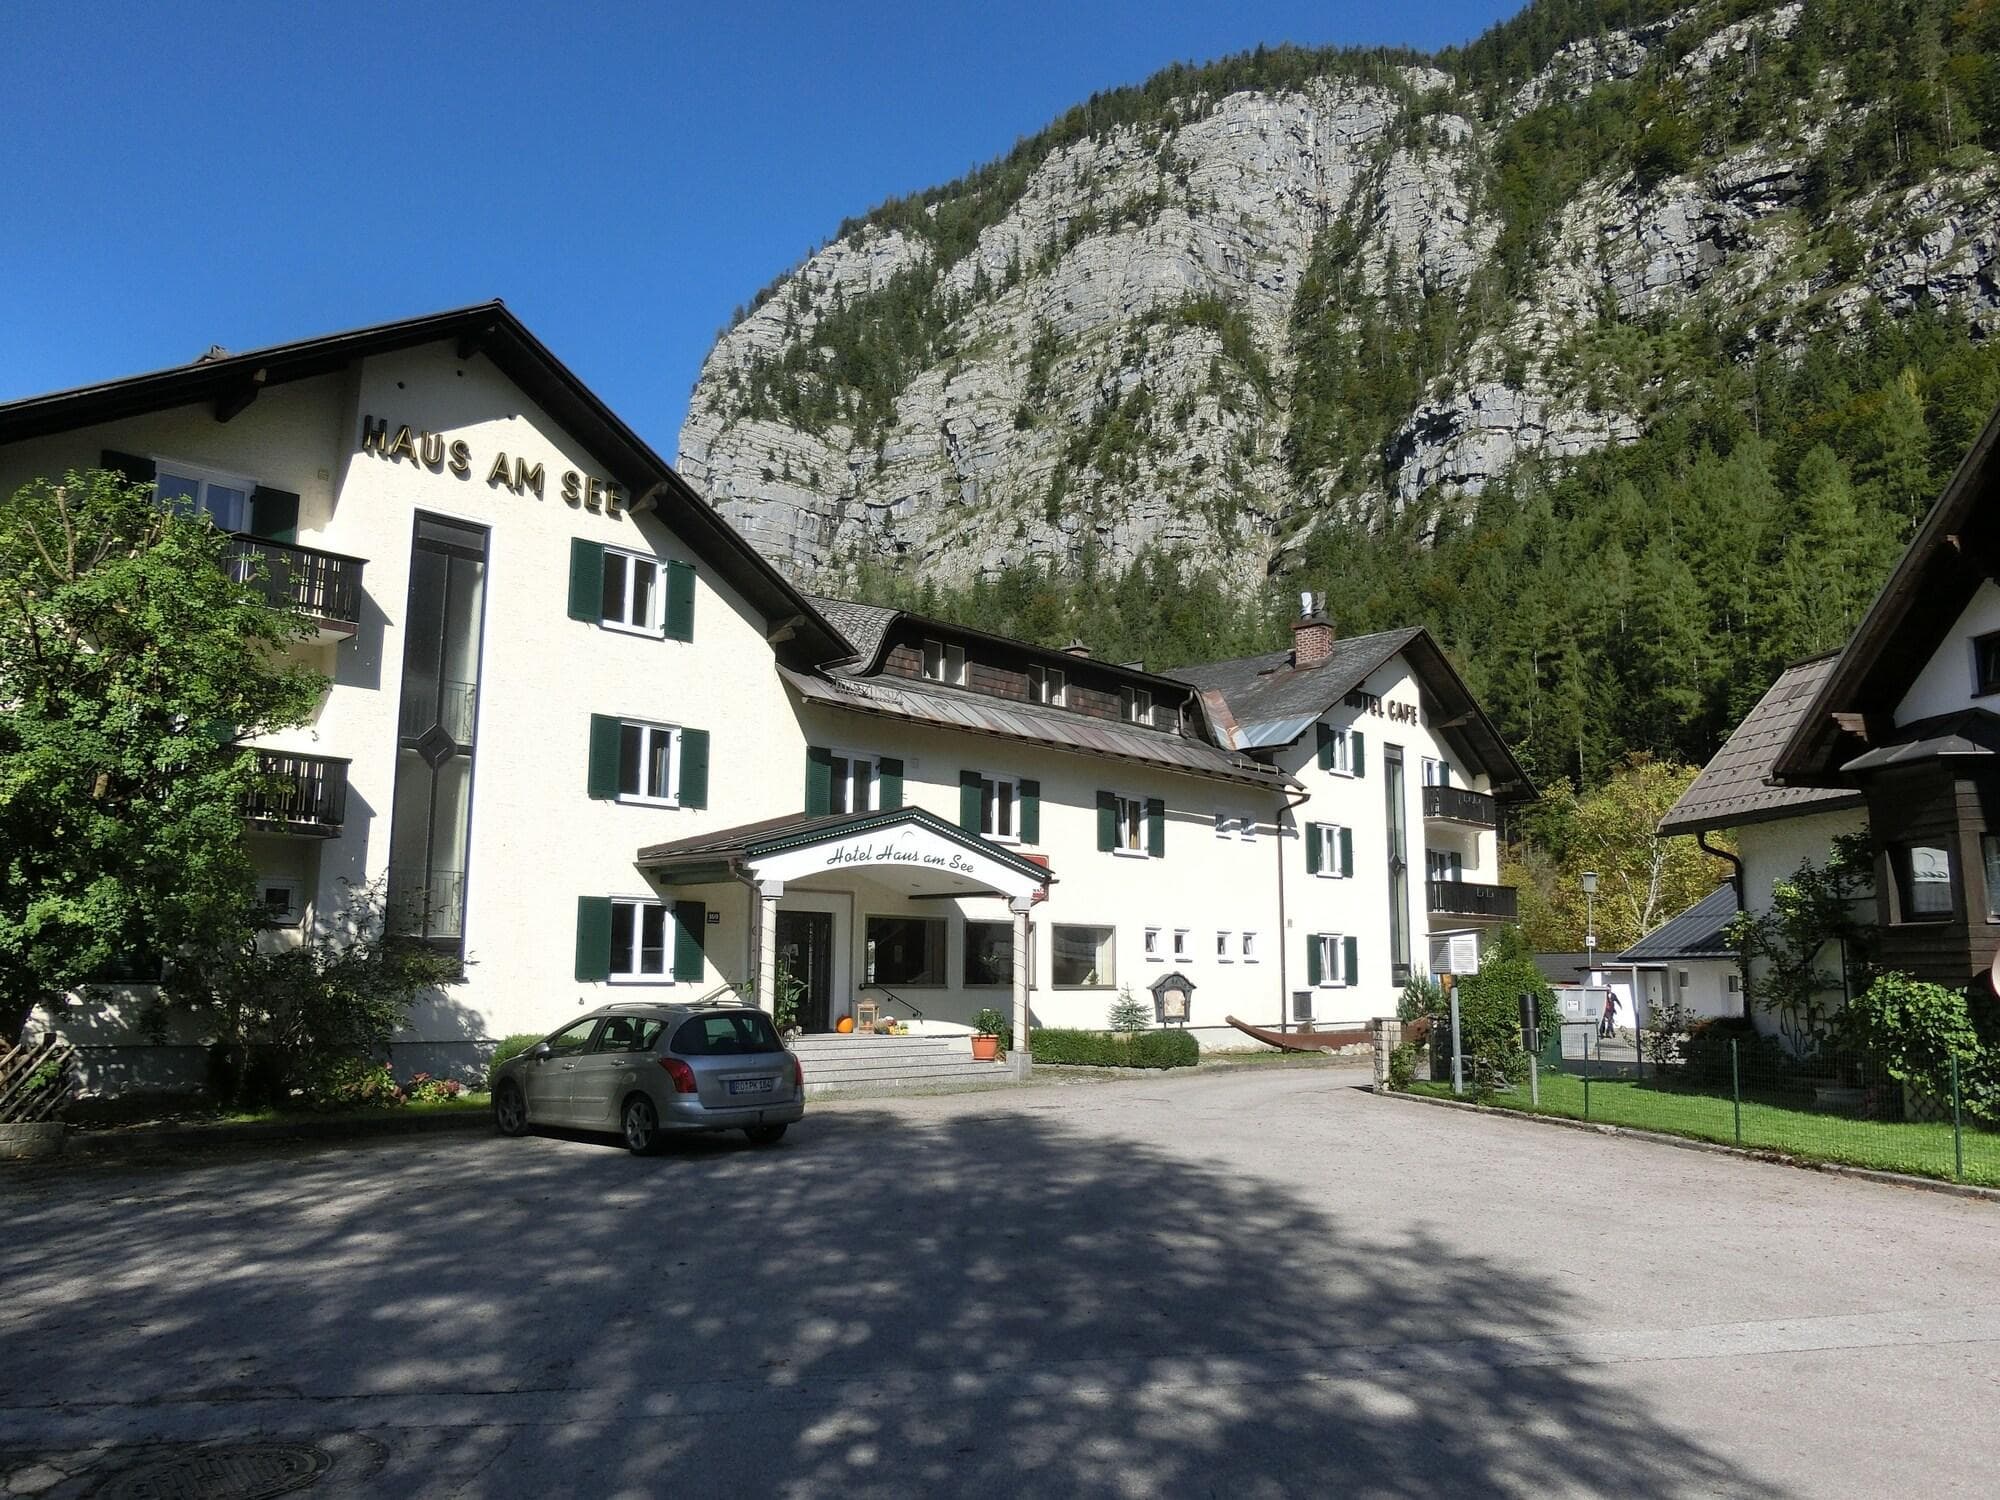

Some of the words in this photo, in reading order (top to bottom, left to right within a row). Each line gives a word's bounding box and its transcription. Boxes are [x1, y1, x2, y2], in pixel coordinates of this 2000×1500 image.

[362, 414, 471, 472] HAUS
[486, 451, 546, 495] AM
[561, 469, 624, 515] SEE
[1344, 692, 1384, 718] TEL
[826, 843, 872, 865] Hotel
[875, 843, 920, 861] Haus
[923, 853, 946, 866] am
[948, 853, 975, 873] See
